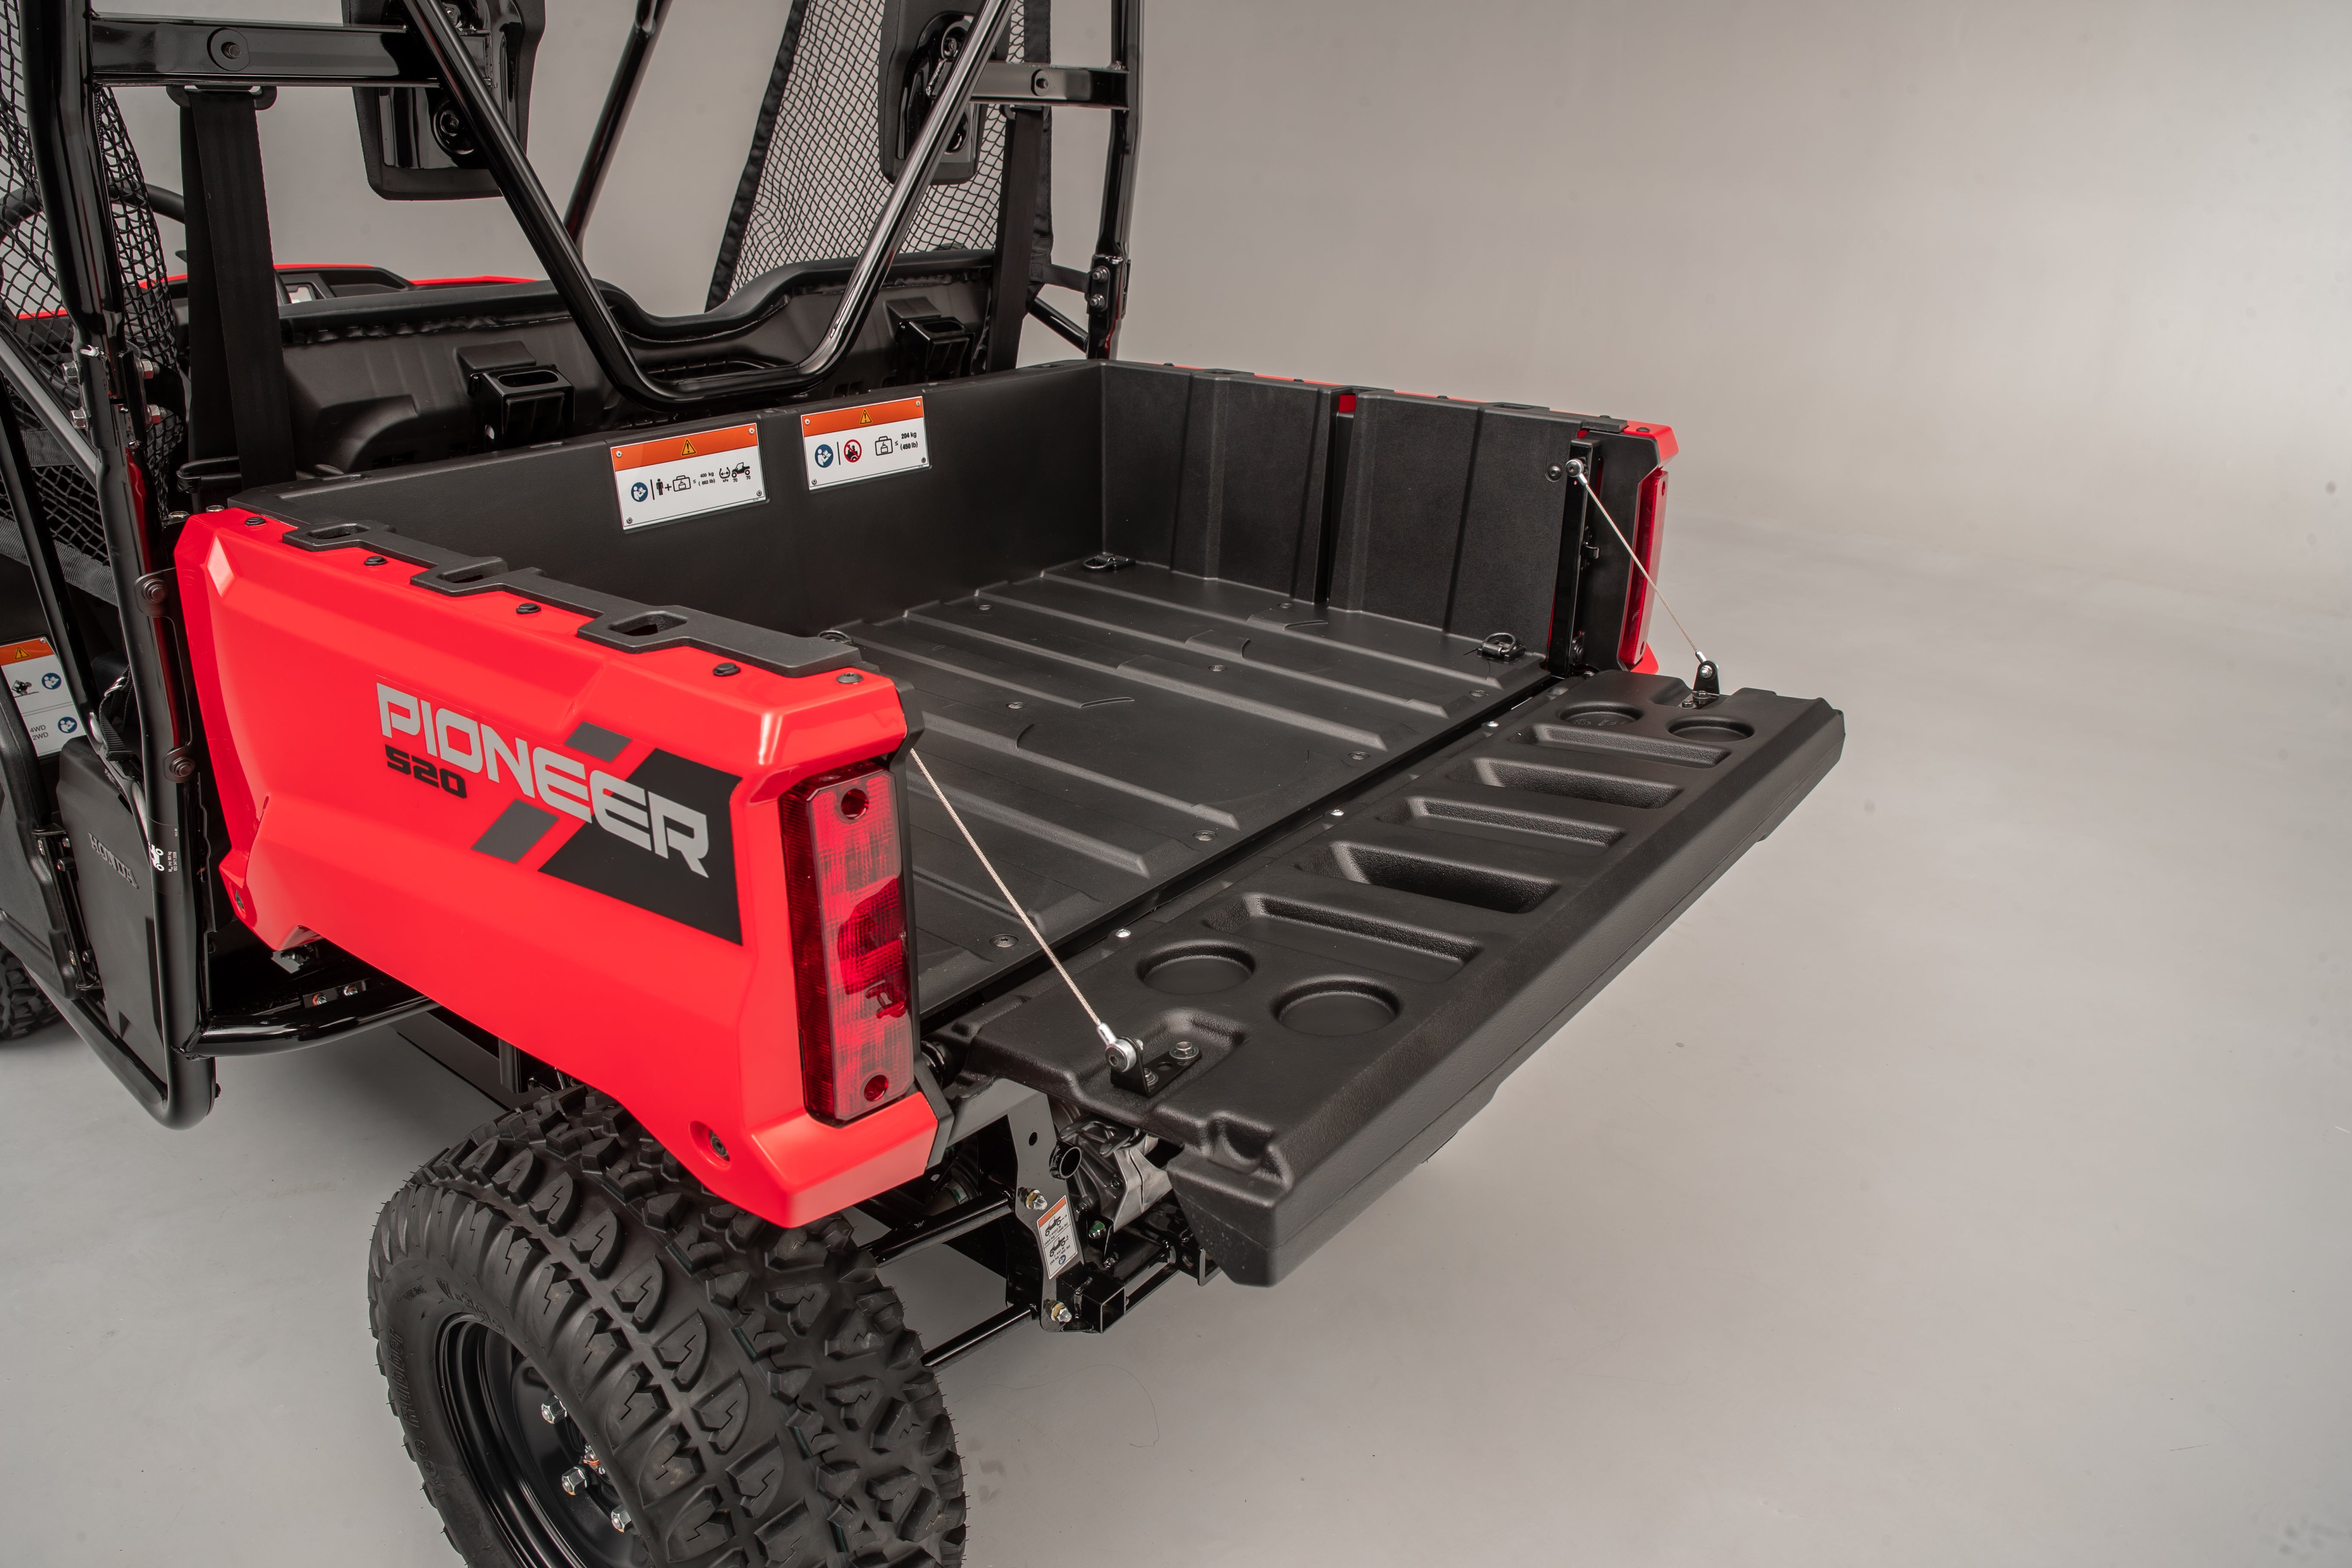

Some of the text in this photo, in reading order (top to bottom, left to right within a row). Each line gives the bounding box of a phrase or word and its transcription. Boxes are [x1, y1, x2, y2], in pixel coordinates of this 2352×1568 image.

[33, 732, 49, 740] 2WD
[377, 682, 709, 877] PIONEER
[385, 744, 467, 799] 520
[88, 832, 138, 889] HONDA
[388, 1326, 419, 1427] Rubber
